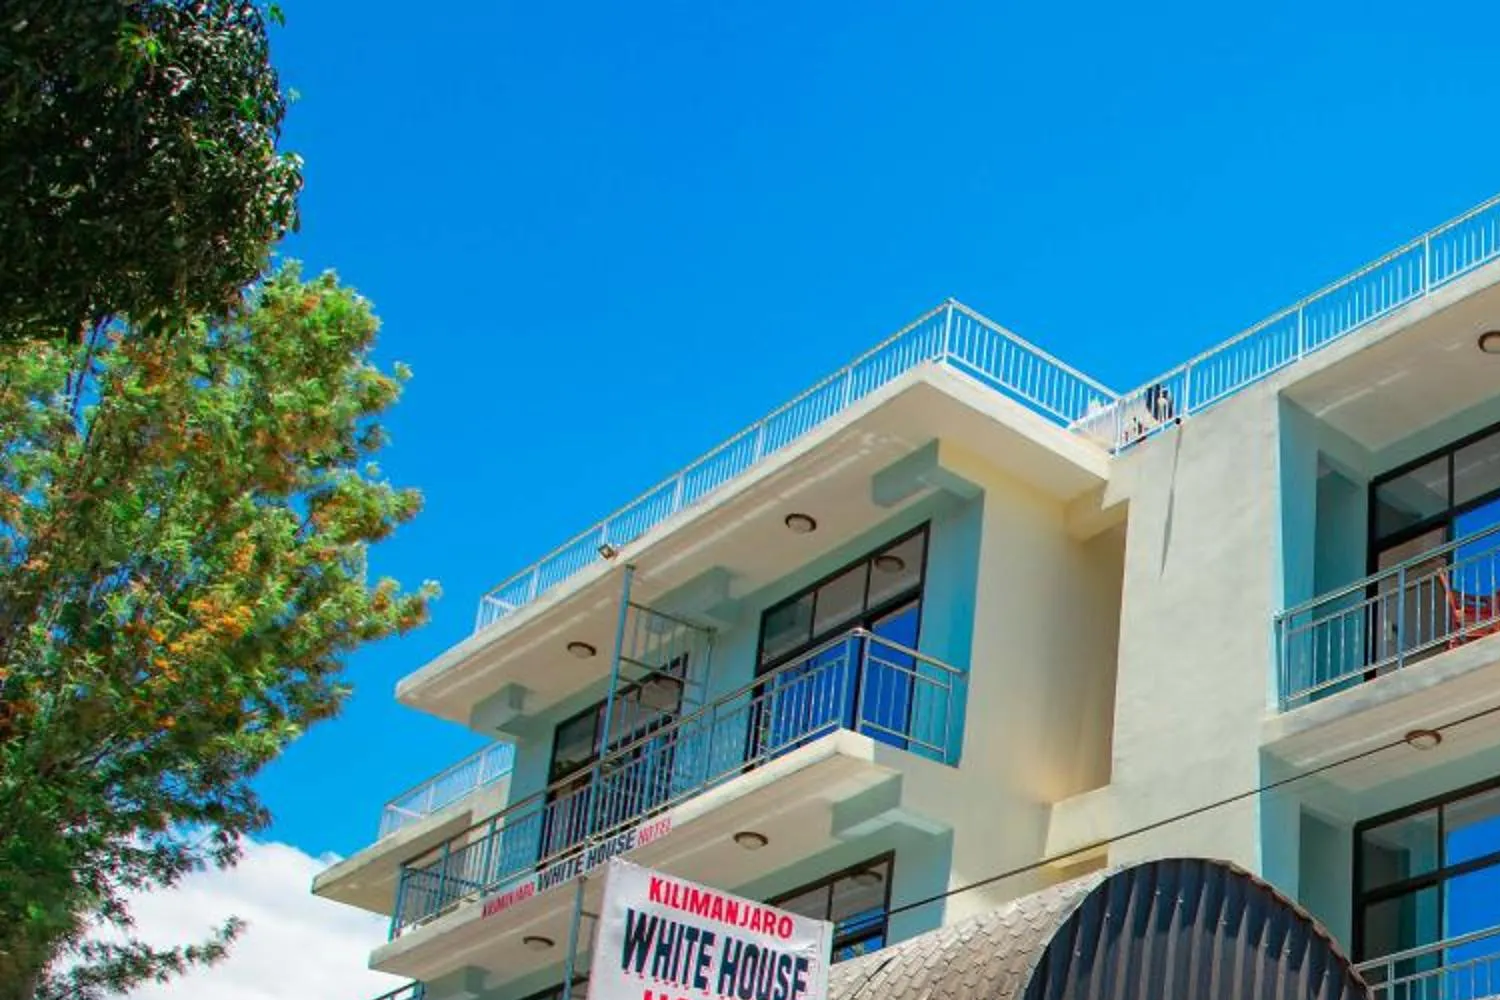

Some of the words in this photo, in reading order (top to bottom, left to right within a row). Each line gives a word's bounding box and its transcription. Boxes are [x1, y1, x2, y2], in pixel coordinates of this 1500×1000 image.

[537, 854, 585, 891] WHITE
[586, 829, 637, 869] HOUSE
[648, 876, 795, 939] KILIMANJARO
[621, 907, 716, 992] WHITE
